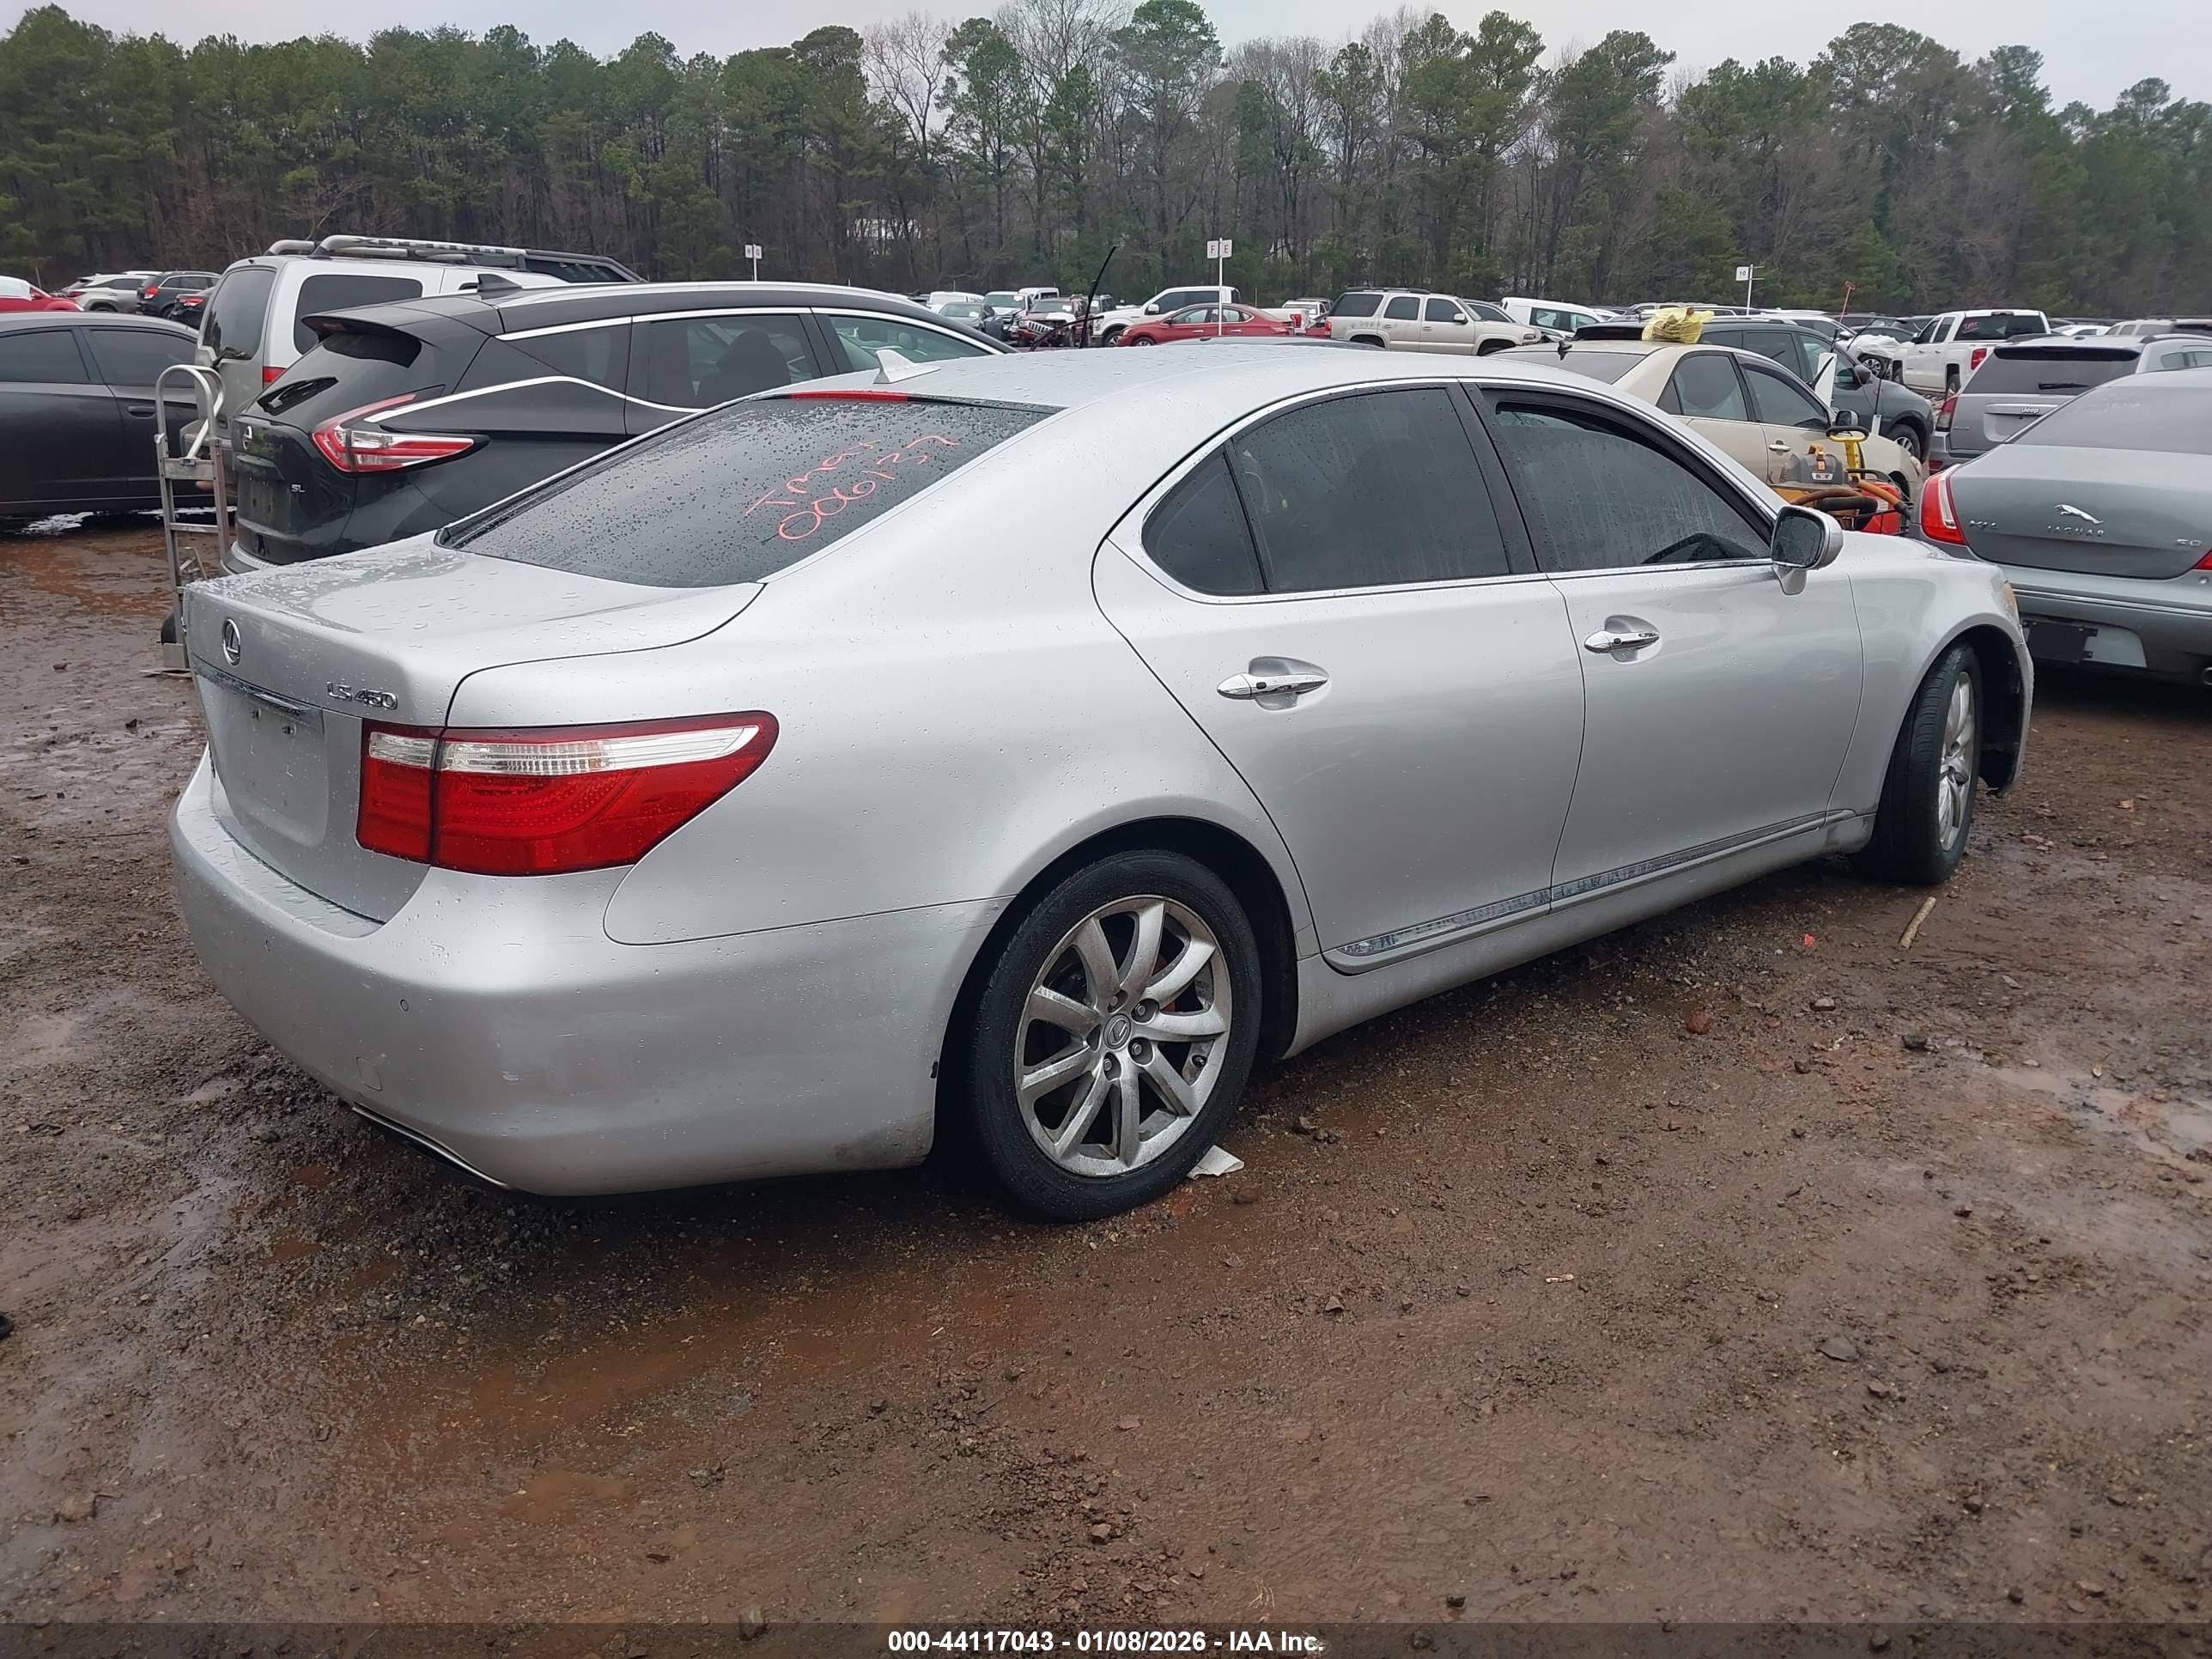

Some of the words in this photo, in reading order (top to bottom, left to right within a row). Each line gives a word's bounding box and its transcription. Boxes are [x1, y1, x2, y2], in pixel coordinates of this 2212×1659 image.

[1211, 245, 1216, 255] F
[1224, 244, 1230, 254] E
[2021, 404, 2040, 414] Jeep
[291, 483, 307, 494] SL
[778, 434, 961, 540] 006137
[2046, 524, 2106, 538] JAGUAR
[325, 681, 353, 702] LS
[354, 688, 399, 710] 450
